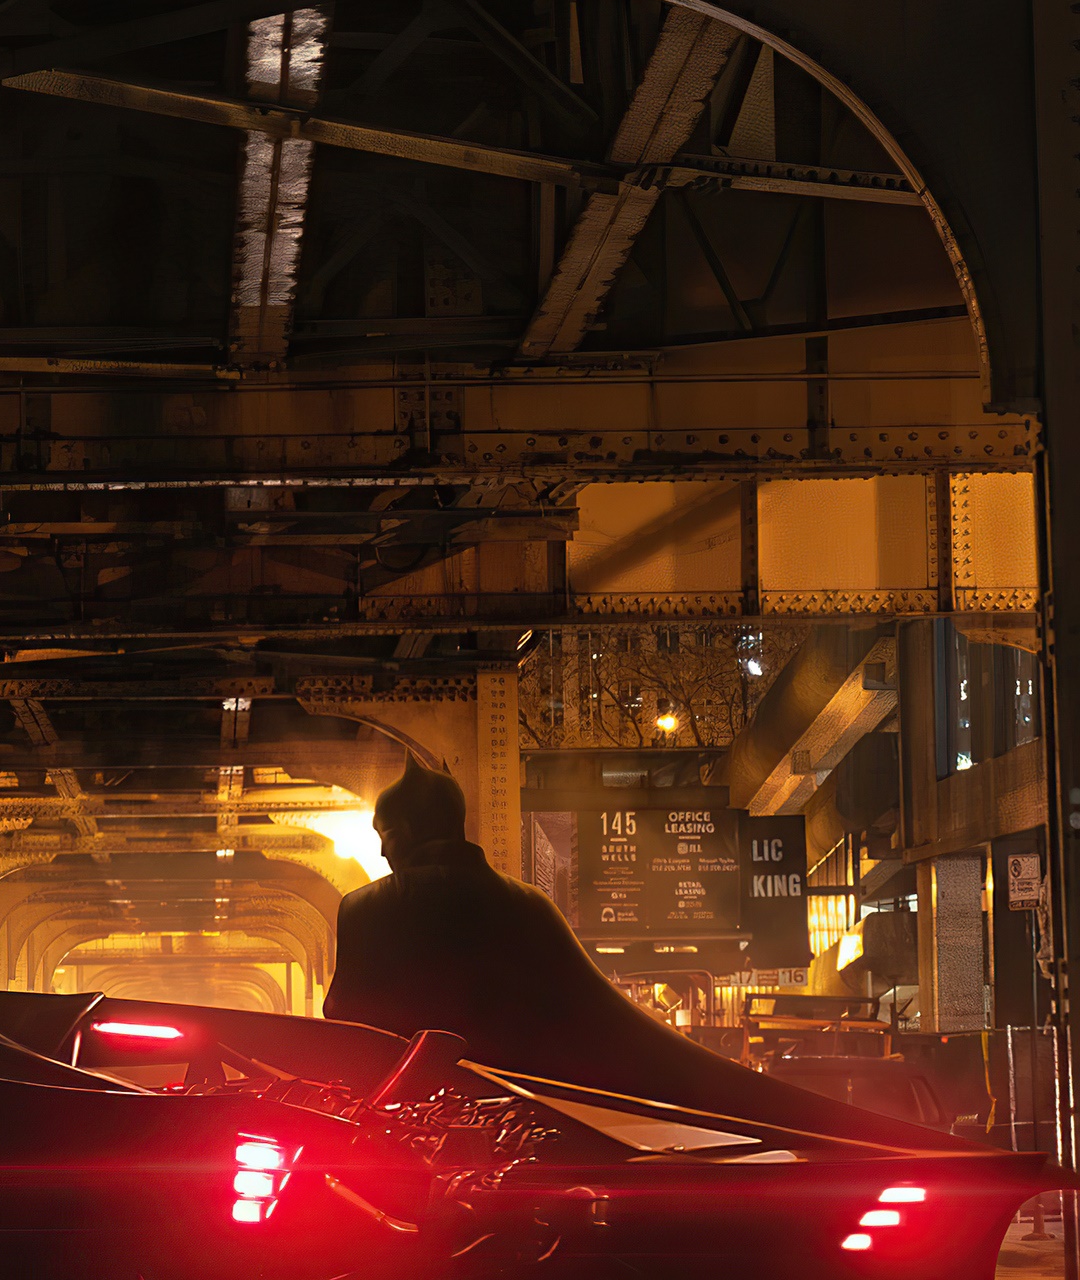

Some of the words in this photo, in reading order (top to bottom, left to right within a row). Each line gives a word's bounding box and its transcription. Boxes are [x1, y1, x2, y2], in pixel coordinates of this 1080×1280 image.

[668, 811, 711, 822] OFFICE
[600, 811, 637, 835] 145
[664, 822, 715, 834] LEASING
